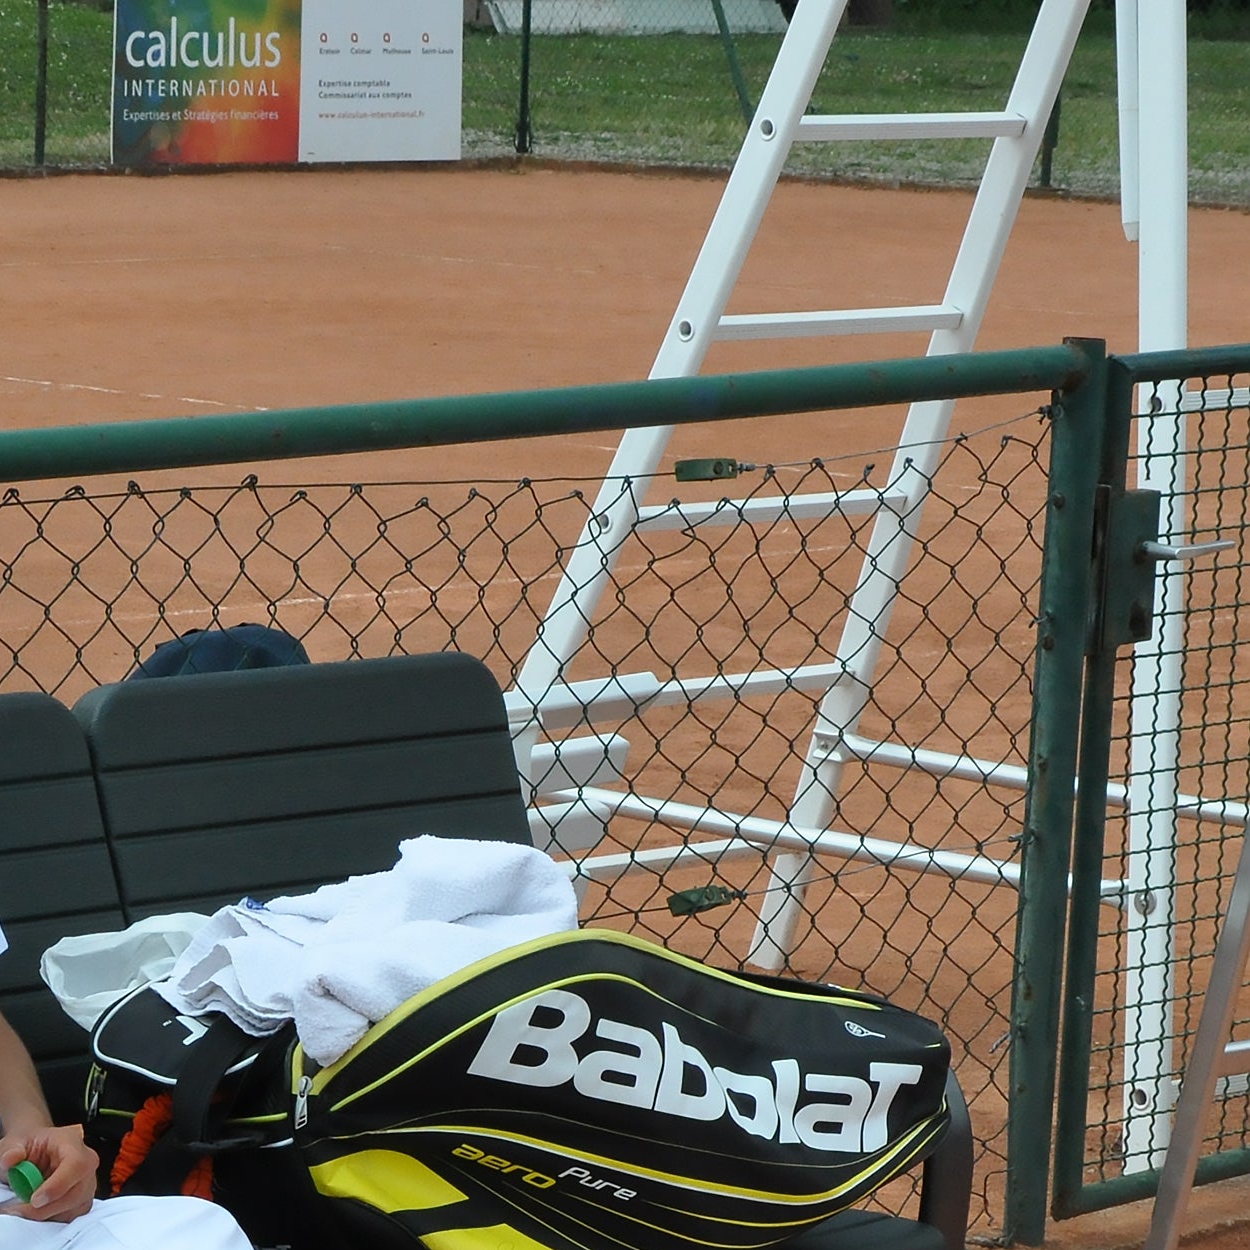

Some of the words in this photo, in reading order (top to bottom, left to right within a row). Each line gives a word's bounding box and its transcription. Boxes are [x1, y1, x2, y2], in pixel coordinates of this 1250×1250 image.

[125, 16, 282, 68] calculus
[123, 79, 280, 97] INTERNATIONAL
[318, 80, 352, 88] Expertise
[318, 91, 367, 100] Commissariat
[123, 108, 170, 122] Expertises
[171, 110, 182, 121] et
[183, 108, 228, 123] Stratégies
[230, 108, 279, 121] financières
[558, 1166, 638, 1201] Pure
